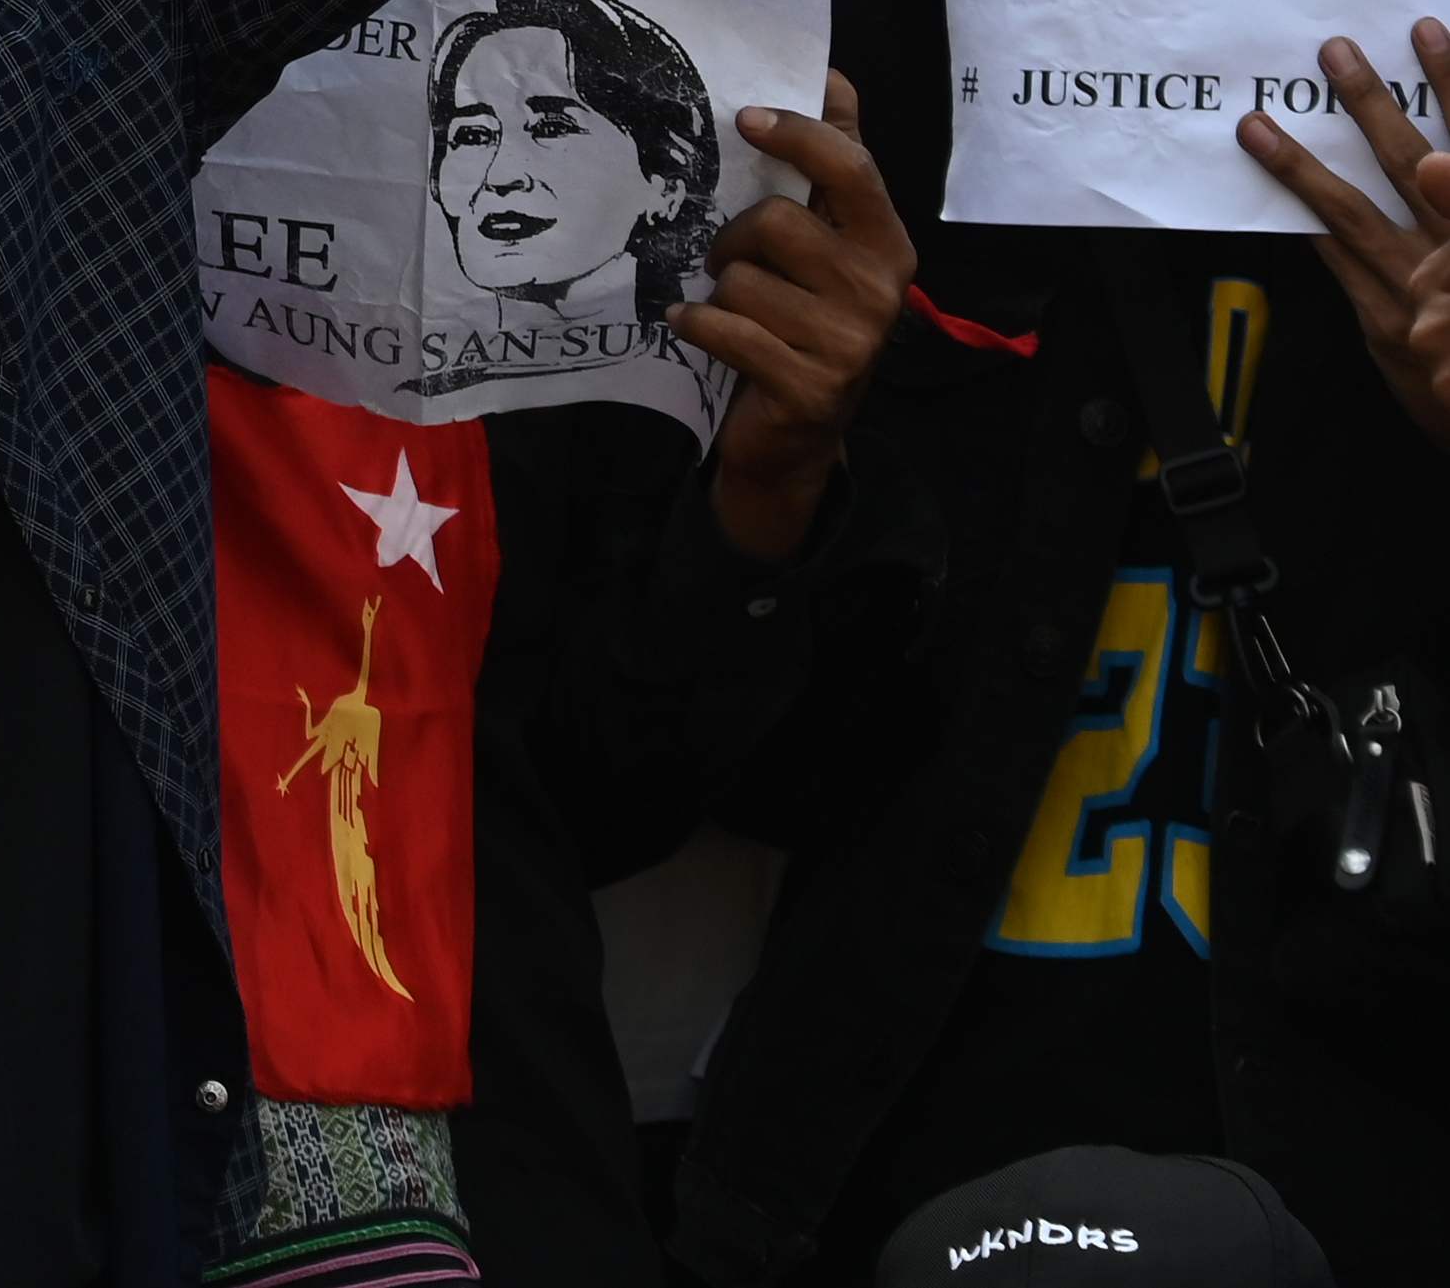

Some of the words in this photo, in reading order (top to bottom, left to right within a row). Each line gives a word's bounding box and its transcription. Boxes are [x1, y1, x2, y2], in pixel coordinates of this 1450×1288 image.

[962, 66, 978, 103] #
[1013, 68, 1222, 112] JUSTICE
[243, 297, 404, 365] AUNG
[422, 329, 544, 372] SAN
[560, 323, 642, 358] SU
[949, 1218, 1139, 1271] WKNDRS
